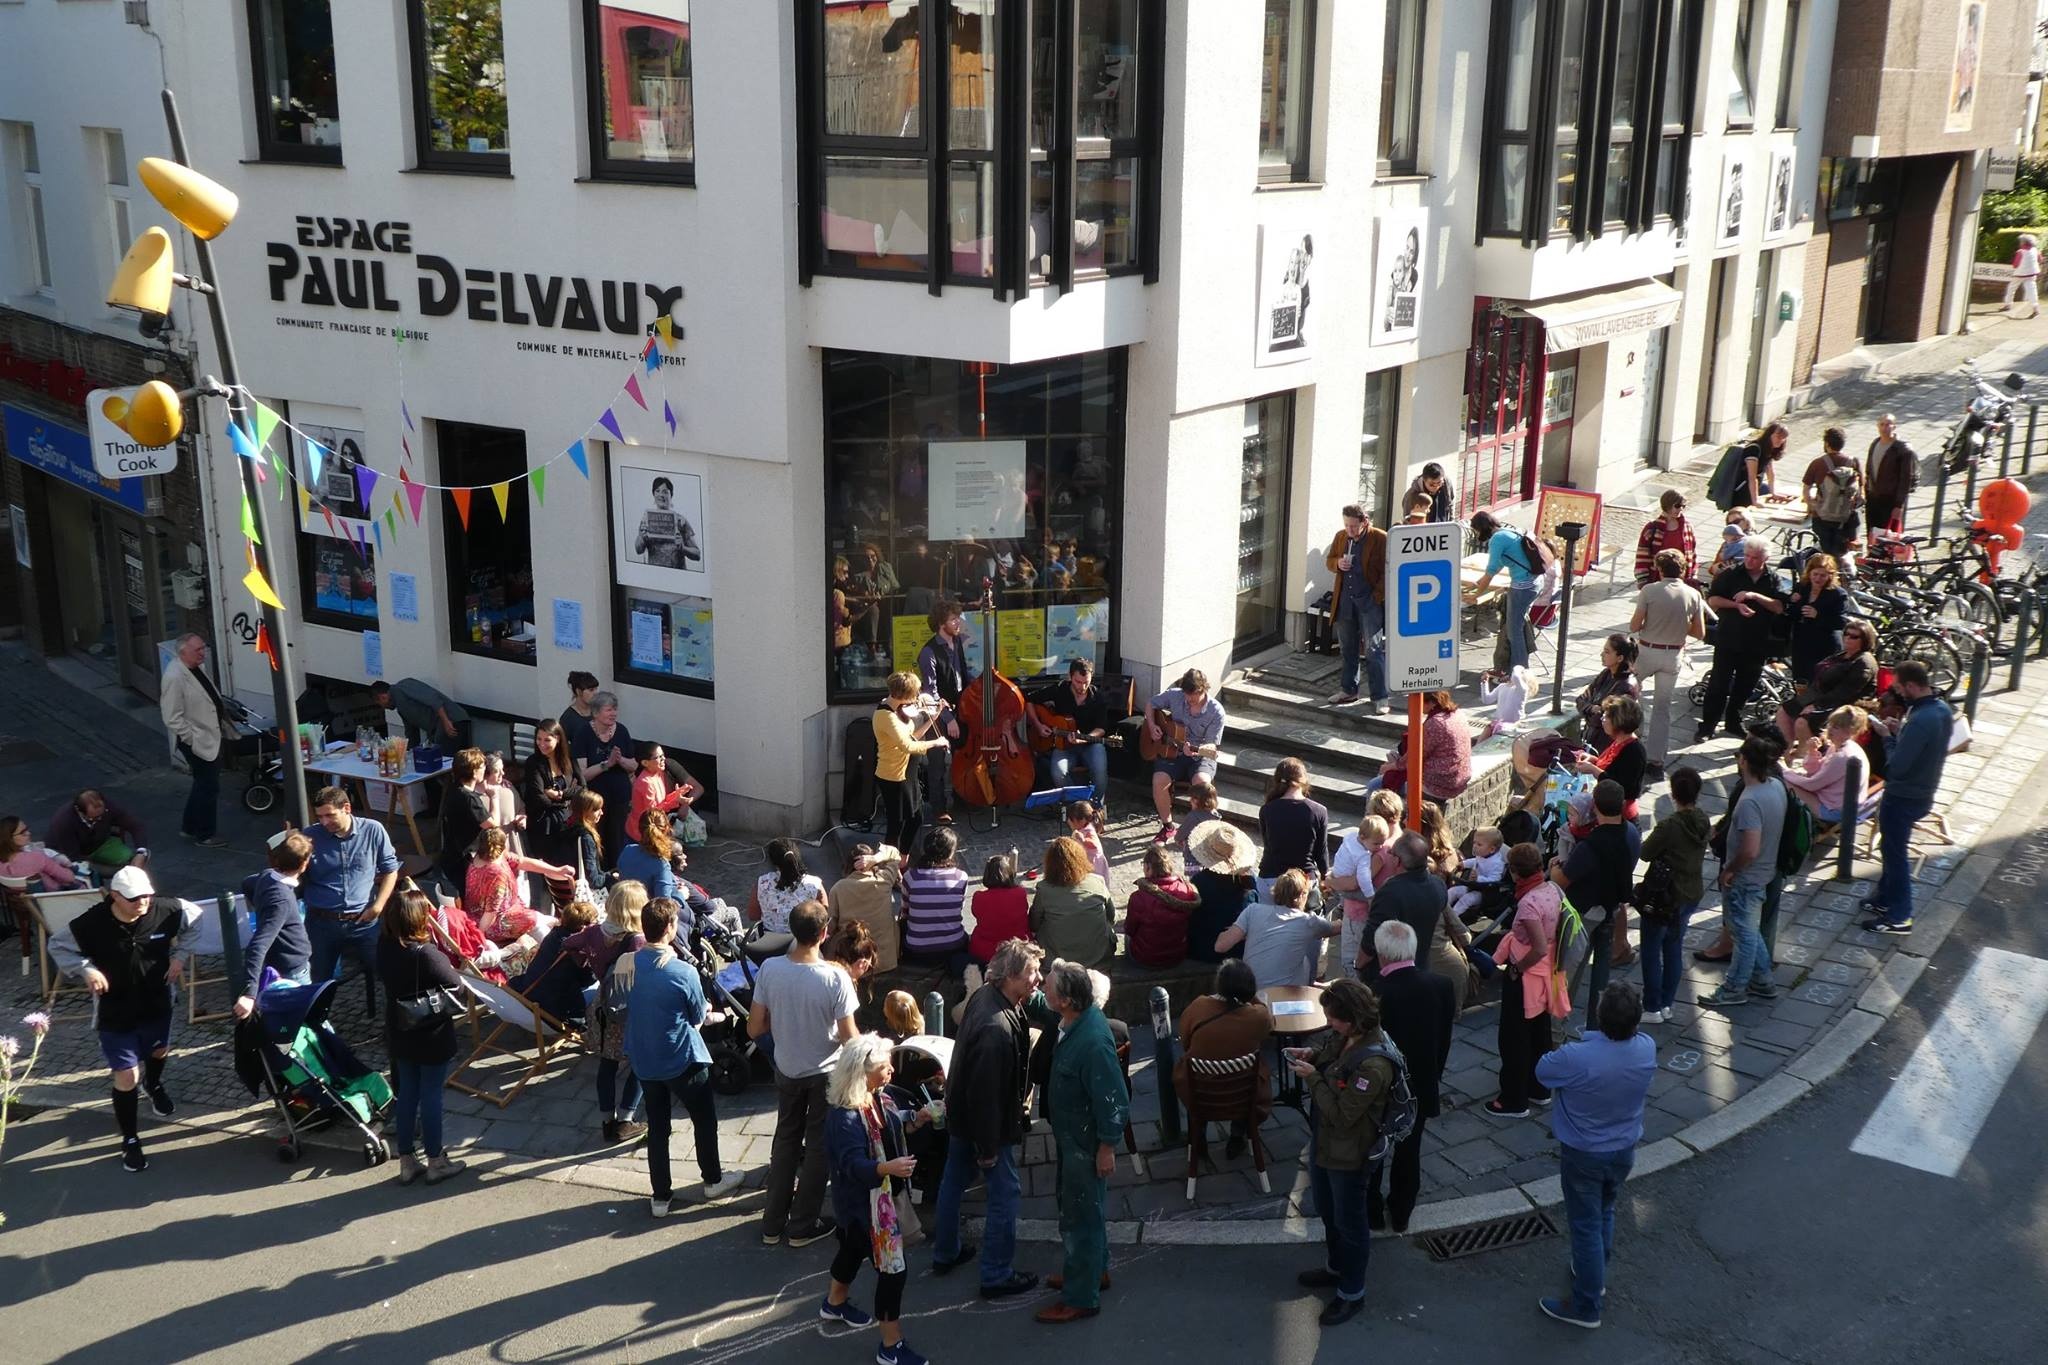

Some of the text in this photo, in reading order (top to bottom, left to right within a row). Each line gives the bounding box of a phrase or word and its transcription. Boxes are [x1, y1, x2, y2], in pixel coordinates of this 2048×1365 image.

[295, 215, 412, 253] ESPACE
[266, 241, 684, 340] PAUL DELVAUX
[276, 317, 324, 330] COMMUNAUTE
[376, 327, 387, 336] DE
[1576, 310, 1657, 341] WWW.LAVENERIE.BE
[517, 341, 557, 354] COMMUNE
[562, 345, 573, 356] DE
[118, 455, 158, 472] Cook
[1401, 535, 1449, 554] ZONE
[1408, 574, 1441, 623] P
[1408, 665, 1438, 676] Rappel
[1402, 678, 1443, 688] Herhaling
